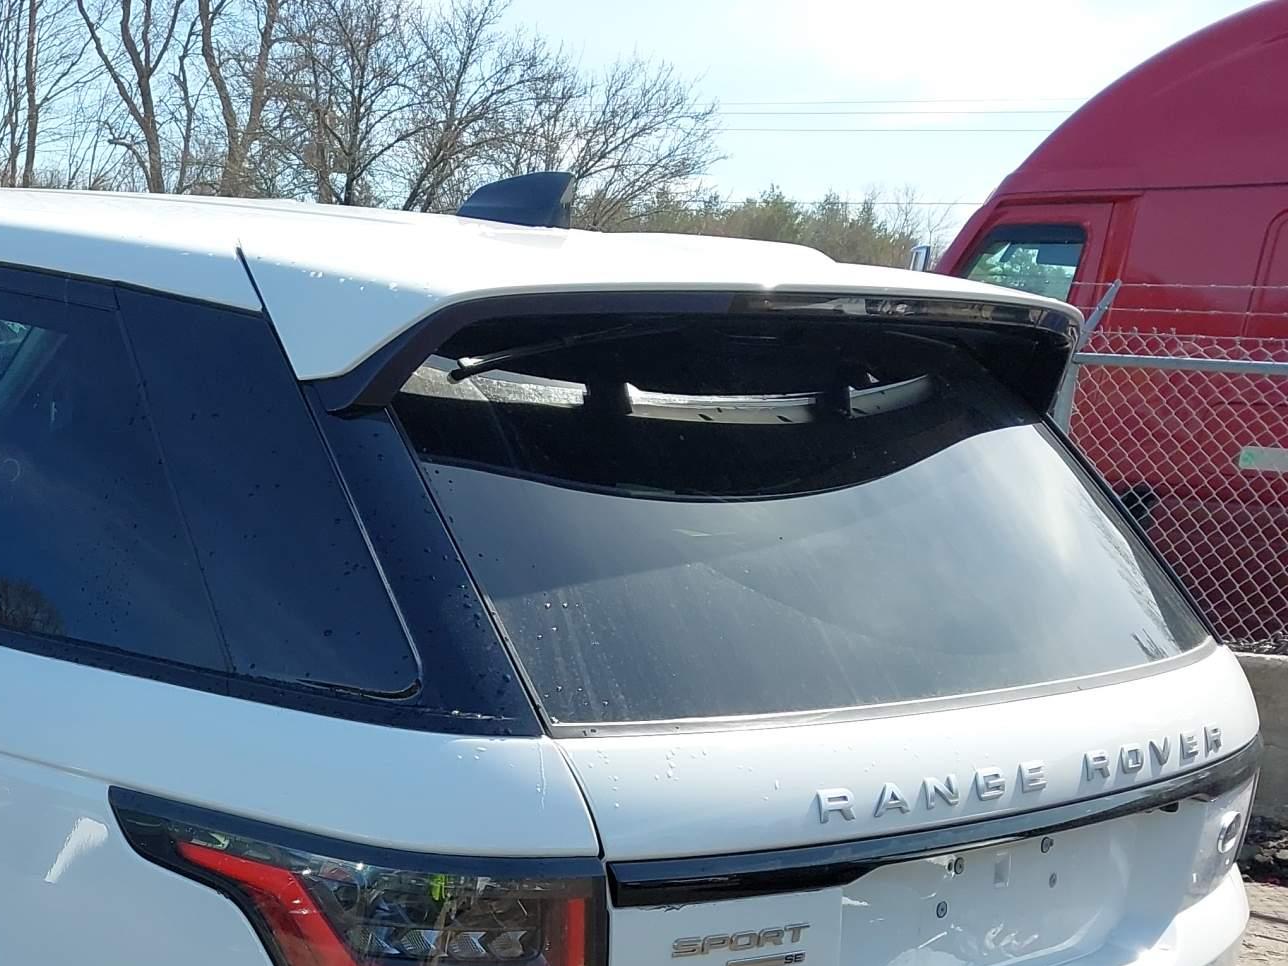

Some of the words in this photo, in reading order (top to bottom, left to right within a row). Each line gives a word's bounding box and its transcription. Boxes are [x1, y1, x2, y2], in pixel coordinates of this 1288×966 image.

[816, 759, 1048, 824] RANGE
[1083, 721, 1224, 781] ROVER
[671, 922, 811, 958] SPORT
[783, 952, 805, 965] SE
